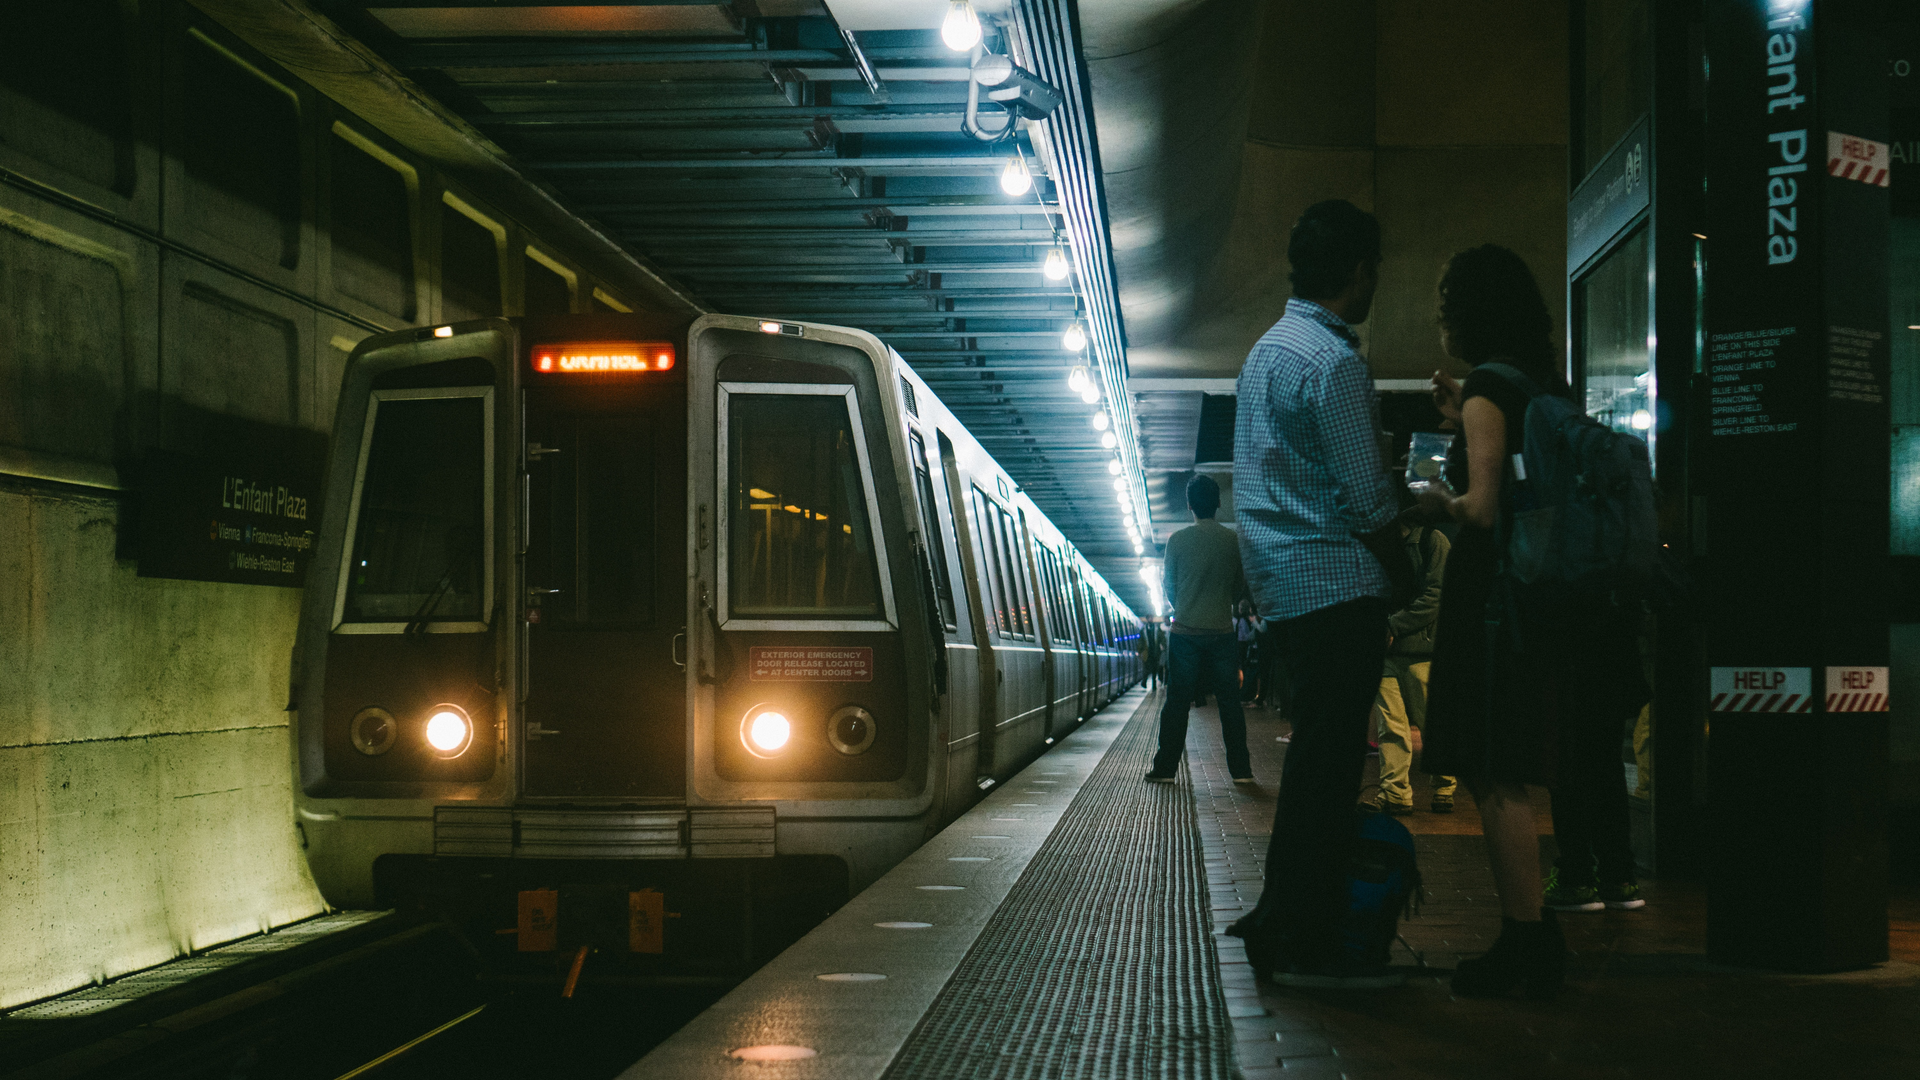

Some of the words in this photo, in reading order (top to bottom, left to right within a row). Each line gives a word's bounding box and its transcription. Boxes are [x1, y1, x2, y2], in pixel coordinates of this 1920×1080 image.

[1842, 138, 1876, 161] HELP
[1767, 128, 1808, 266] Plaza
[1712, 326, 1796, 342] ORANGE/BLUE/SILVER
[1712, 343, 1728, 352] LINE
[1730, 341, 1742, 350] ON
[1744, 340, 1761, 349] THIS
[1762, 338, 1781, 347] SIDE
[1712, 351, 1747, 362] L'ENFANT
[1749, 349, 1774, 358] PLAZA
[1712, 363, 1745, 373] ORANGE
[1746, 361, 1763, 371] LINE
[1765, 360, 1776, 369] TO
[1712, 374, 1741, 383] VIENNA
[1712, 386, 1732, 395] BLUE
[1734, 385, 1751, 394] LINE
[1752, 384, 1764, 392] TO
[1712, 395, 1760, 405] FRANCONIA-
[1712, 403, 1763, 414] SPRINGFIELD
[1712, 417, 1738, 426] SILVER
[1740, 416, 1757, 425] LINE
[1758, 415, 1769, 423] TO
[1712, 425, 1776, 436] WIEHLE-RESTON
[1777, 423, 1798, 432] EAST
[222, 476, 273, 515] L'Enfant
[275, 486, 307, 520] Plaza
[218, 522, 241, 541] Vienna
[236, 552, 281, 573] Wiehle-Reston
[281, 557, 295, 573] East
[761, 651, 805, 659] EXTERIOR
[807, 651, 862, 659] EMERGENCY
[757, 660, 782, 668] DOOR
[784, 660, 823, 668] RELEASE
[826, 660, 866, 668] LOCATED
[1734, 671, 1786, 690] HELP
[1842, 671, 1875, 690] HELP
